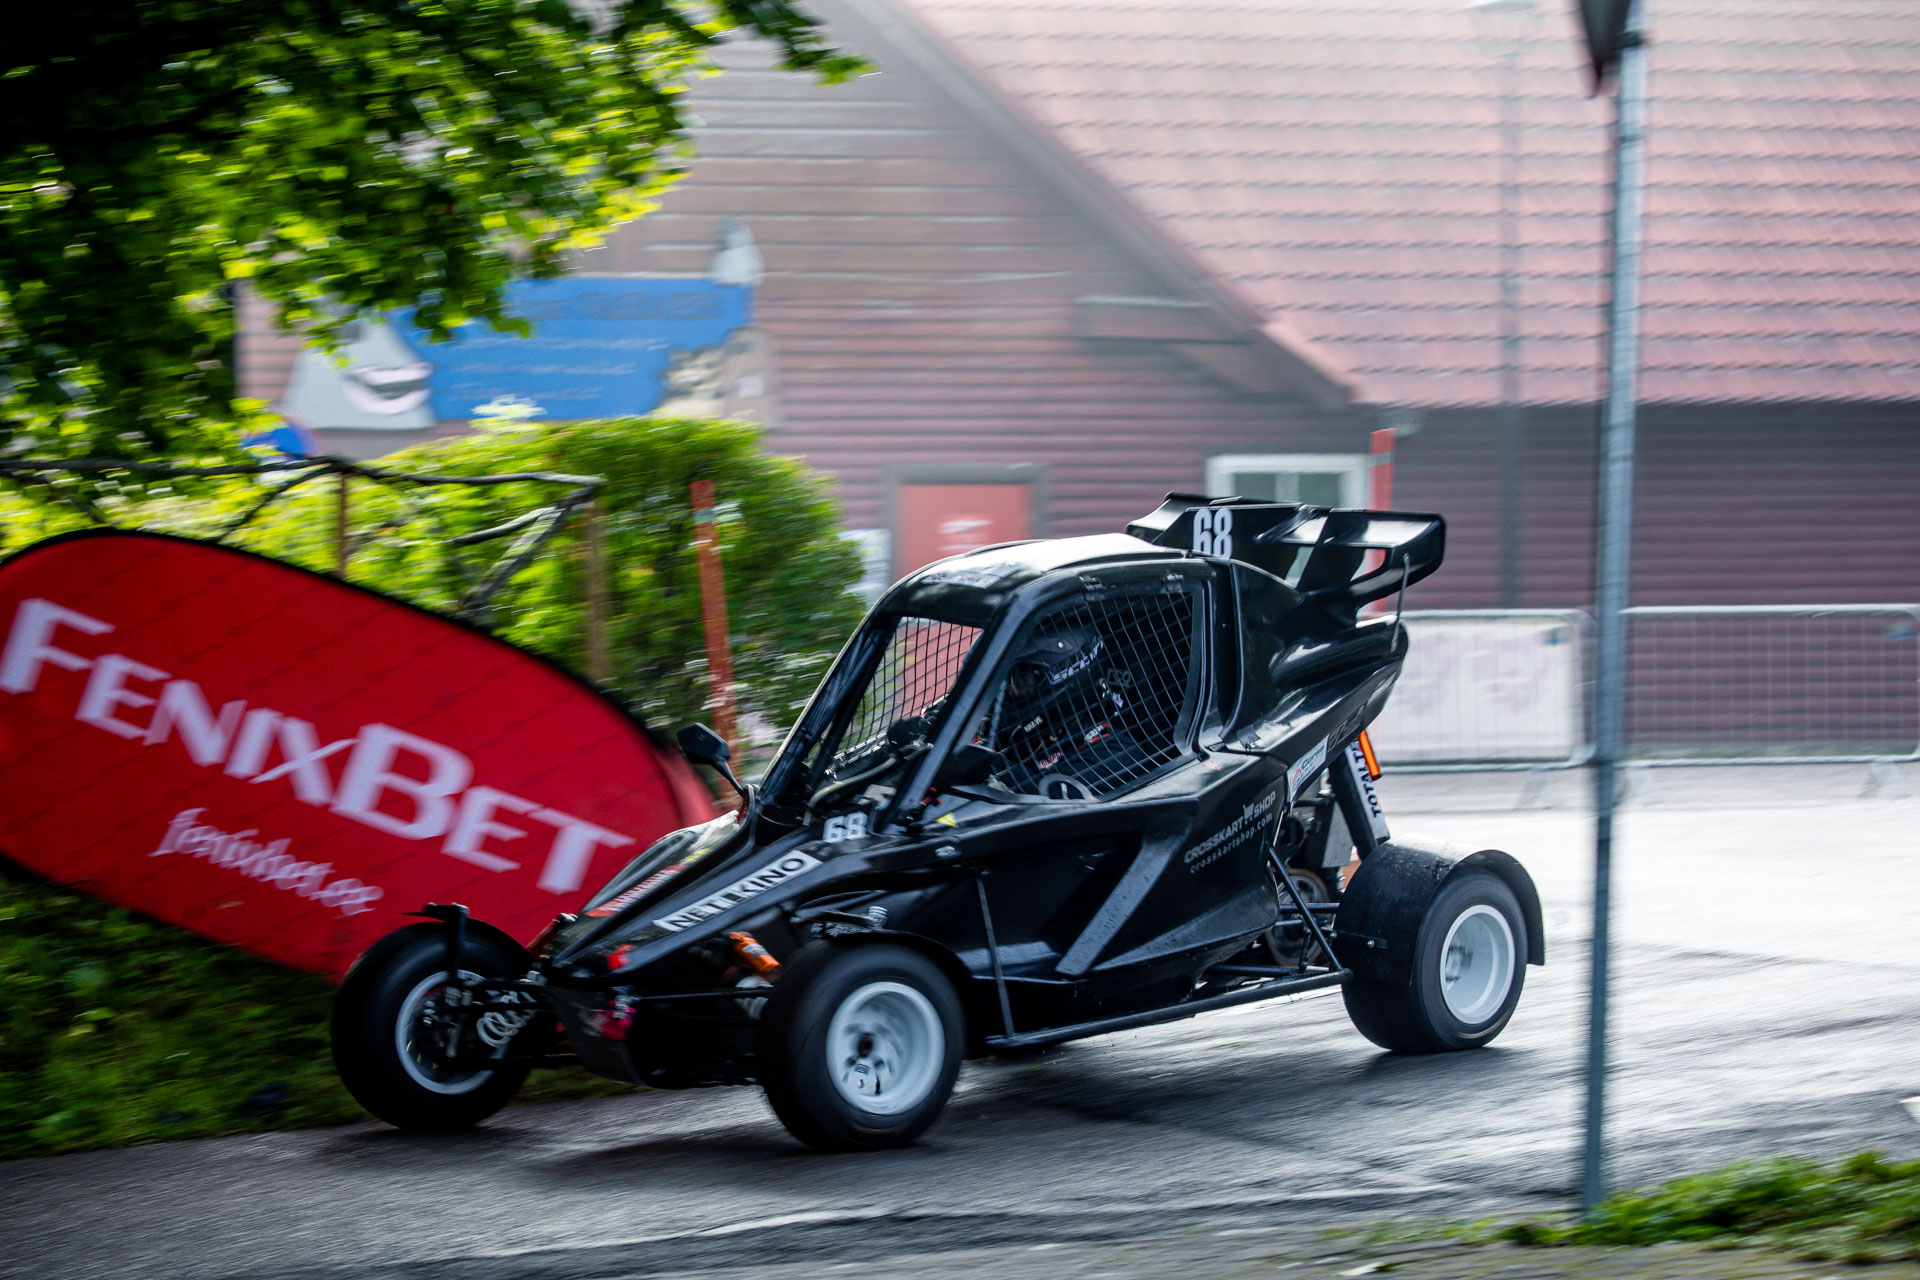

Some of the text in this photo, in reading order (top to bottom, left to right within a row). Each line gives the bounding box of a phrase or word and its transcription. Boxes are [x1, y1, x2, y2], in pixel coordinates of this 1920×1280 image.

[1193, 508, 1233, 560] 68
[822, 811, 868, 844] 68
[1184, 790, 1277, 865] CROSSKART SHOP
[1189, 812, 1273, 875] crosskartshop.com
